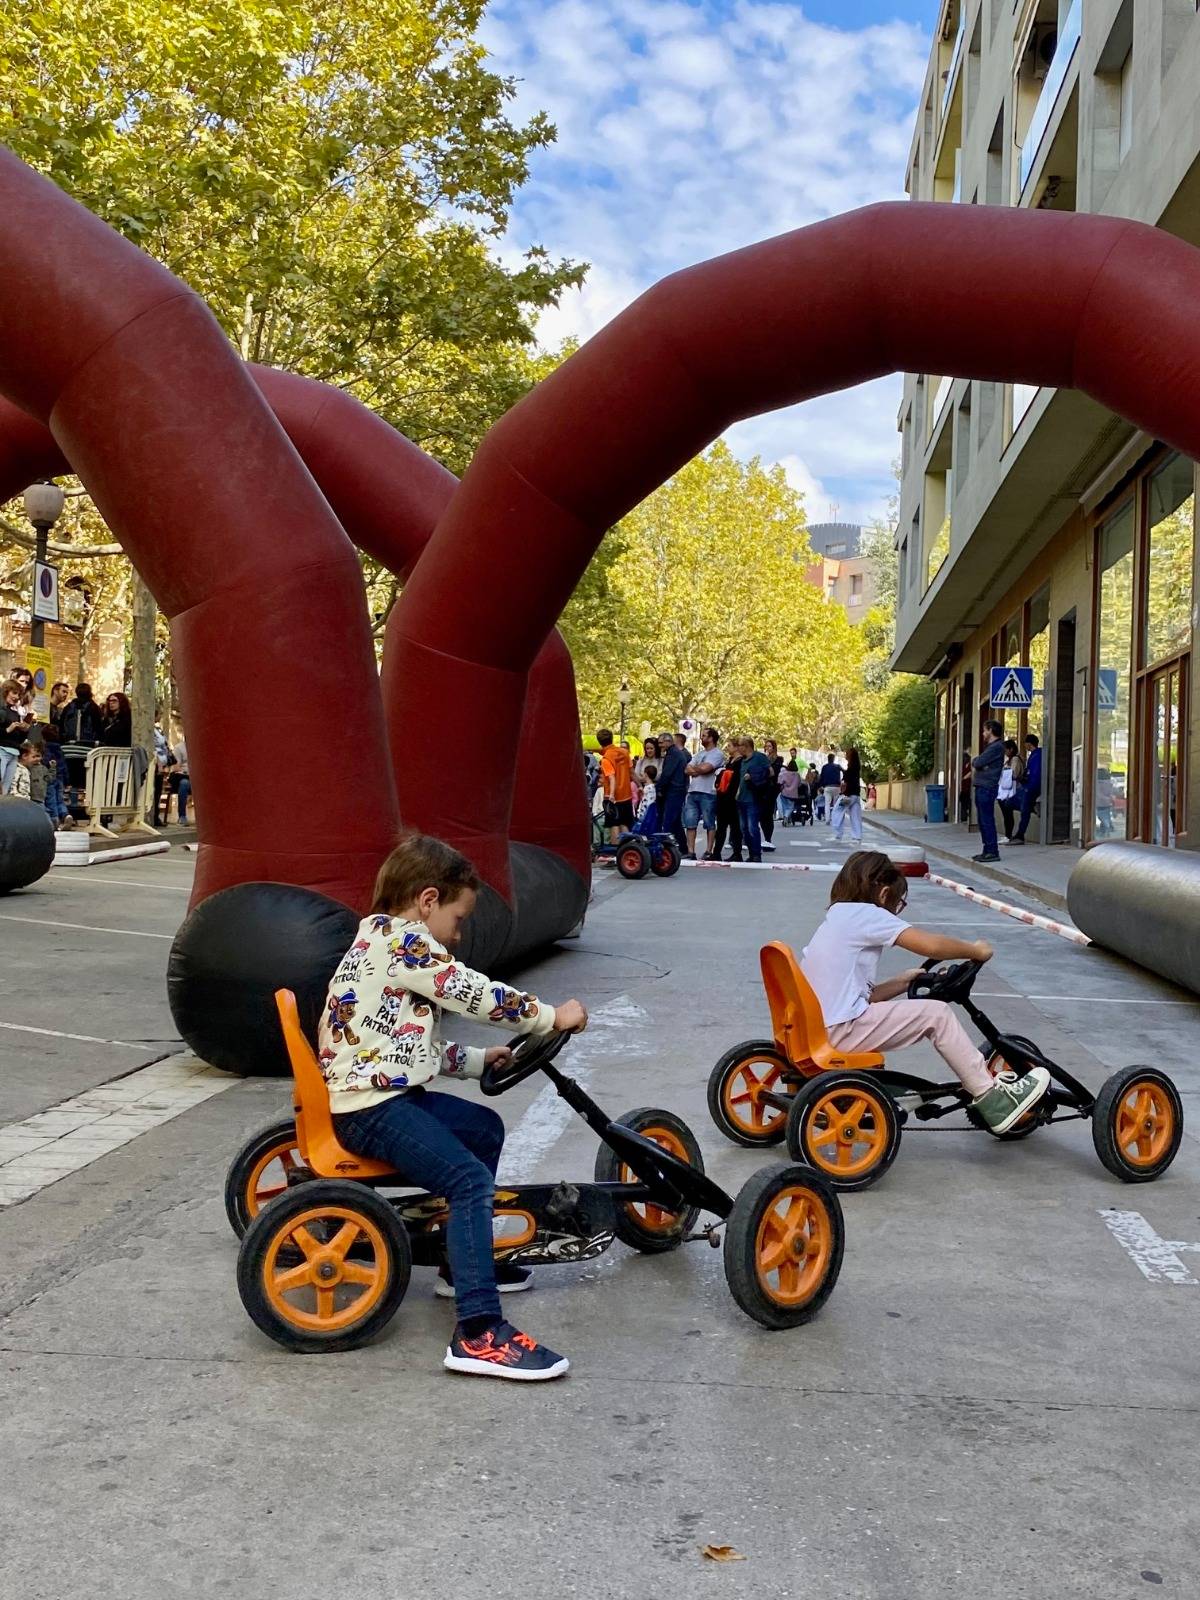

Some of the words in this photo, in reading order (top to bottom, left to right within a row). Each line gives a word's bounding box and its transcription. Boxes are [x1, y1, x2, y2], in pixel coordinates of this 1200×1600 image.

[455, 979, 474, 1003] PAW
[376, 1006, 398, 1027] PAW
[395, 1043, 415, 1055] AW
